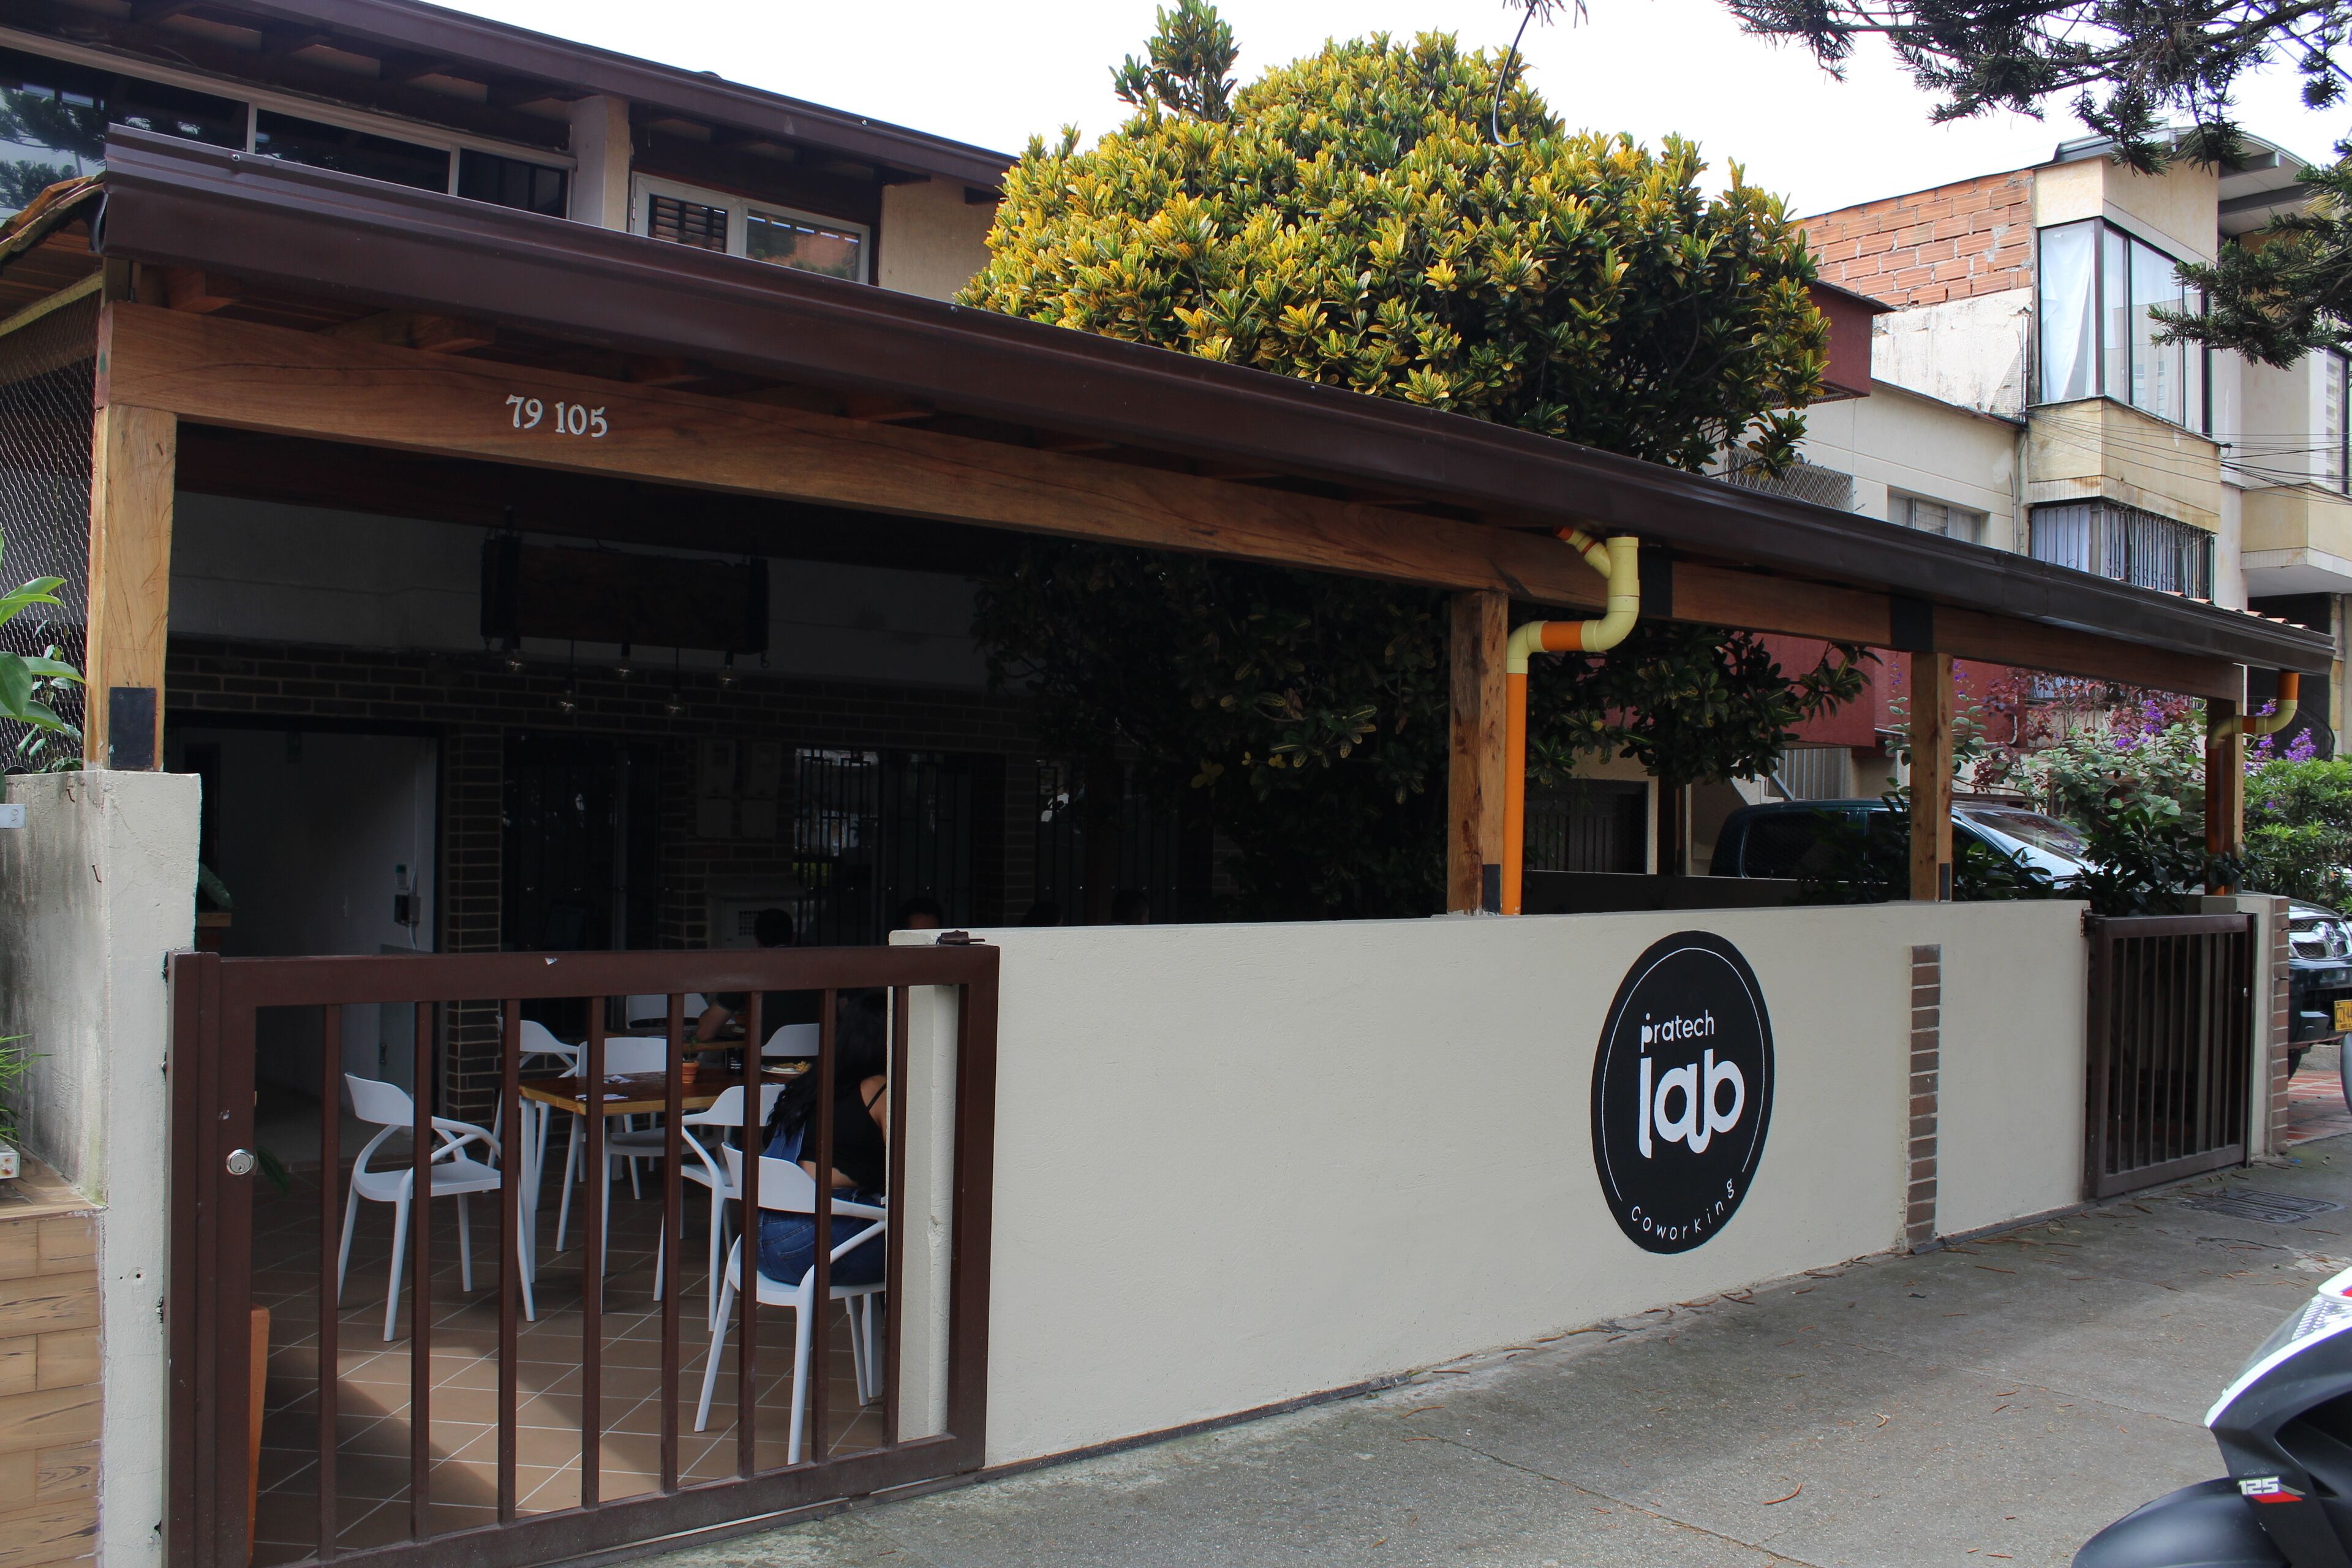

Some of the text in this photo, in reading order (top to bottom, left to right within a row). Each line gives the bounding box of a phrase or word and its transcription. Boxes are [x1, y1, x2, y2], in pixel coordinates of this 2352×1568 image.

[505, 394, 608, 437] 79 105
[1641, 1009, 1714, 1053] pratech
[1638, 1048, 1745, 1159] lab
[2237, 1476, 2279, 1496] 125
